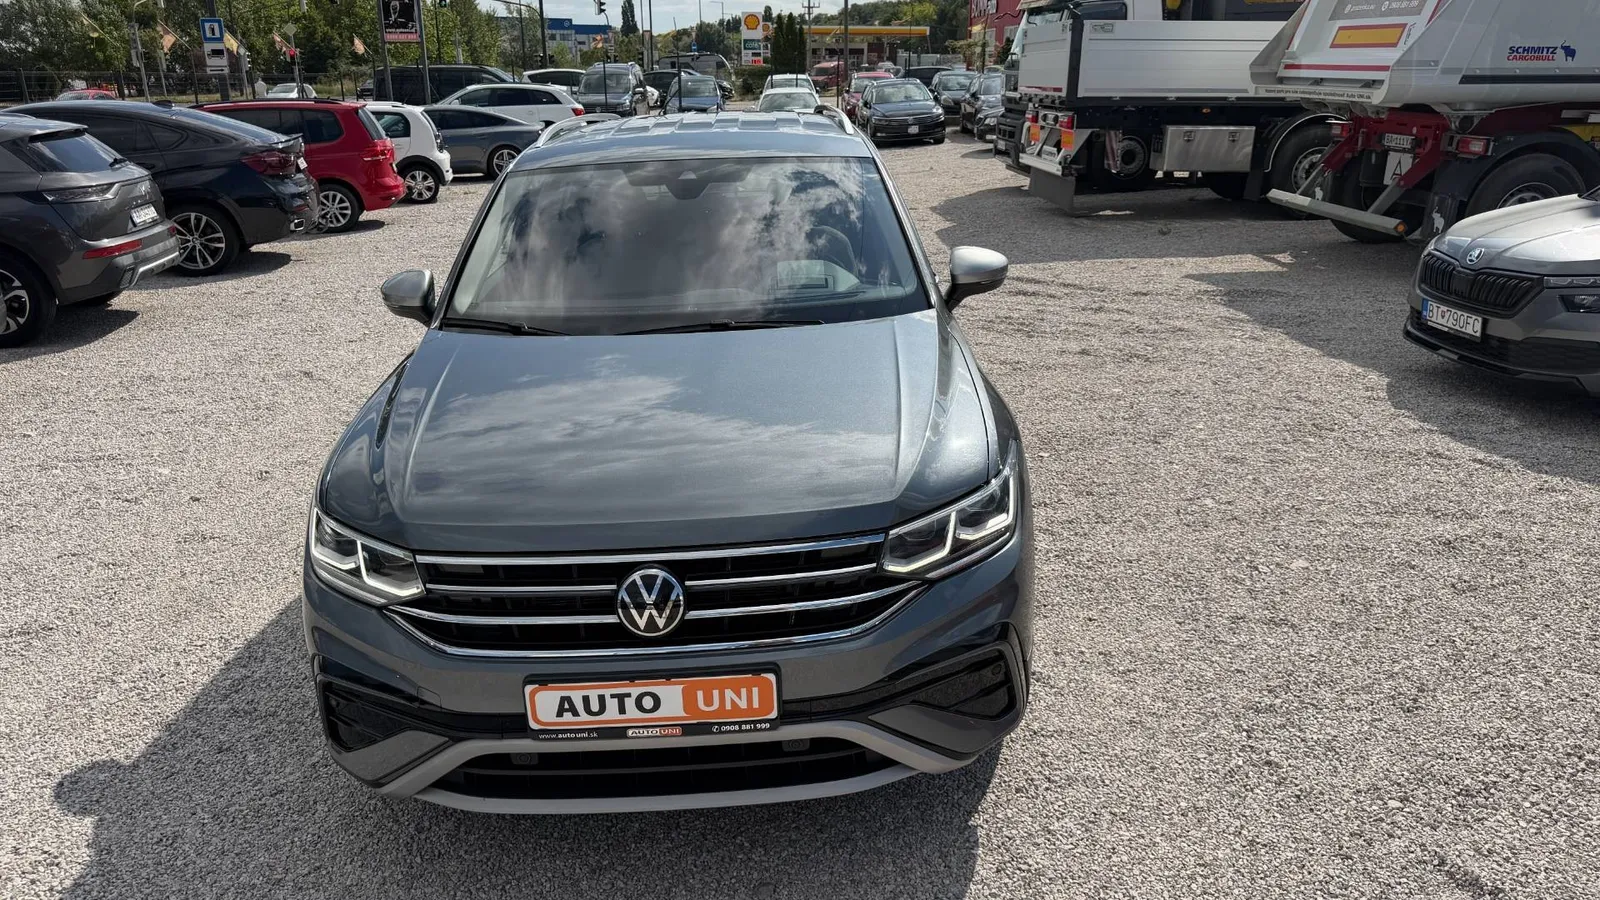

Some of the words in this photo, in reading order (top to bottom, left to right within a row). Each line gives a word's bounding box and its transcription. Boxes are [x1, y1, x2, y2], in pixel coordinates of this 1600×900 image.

[1508, 46, 1558, 54] SCHMITZ
[556, 691, 662, 718] AUTO
[696, 687, 760, 712] UNI
